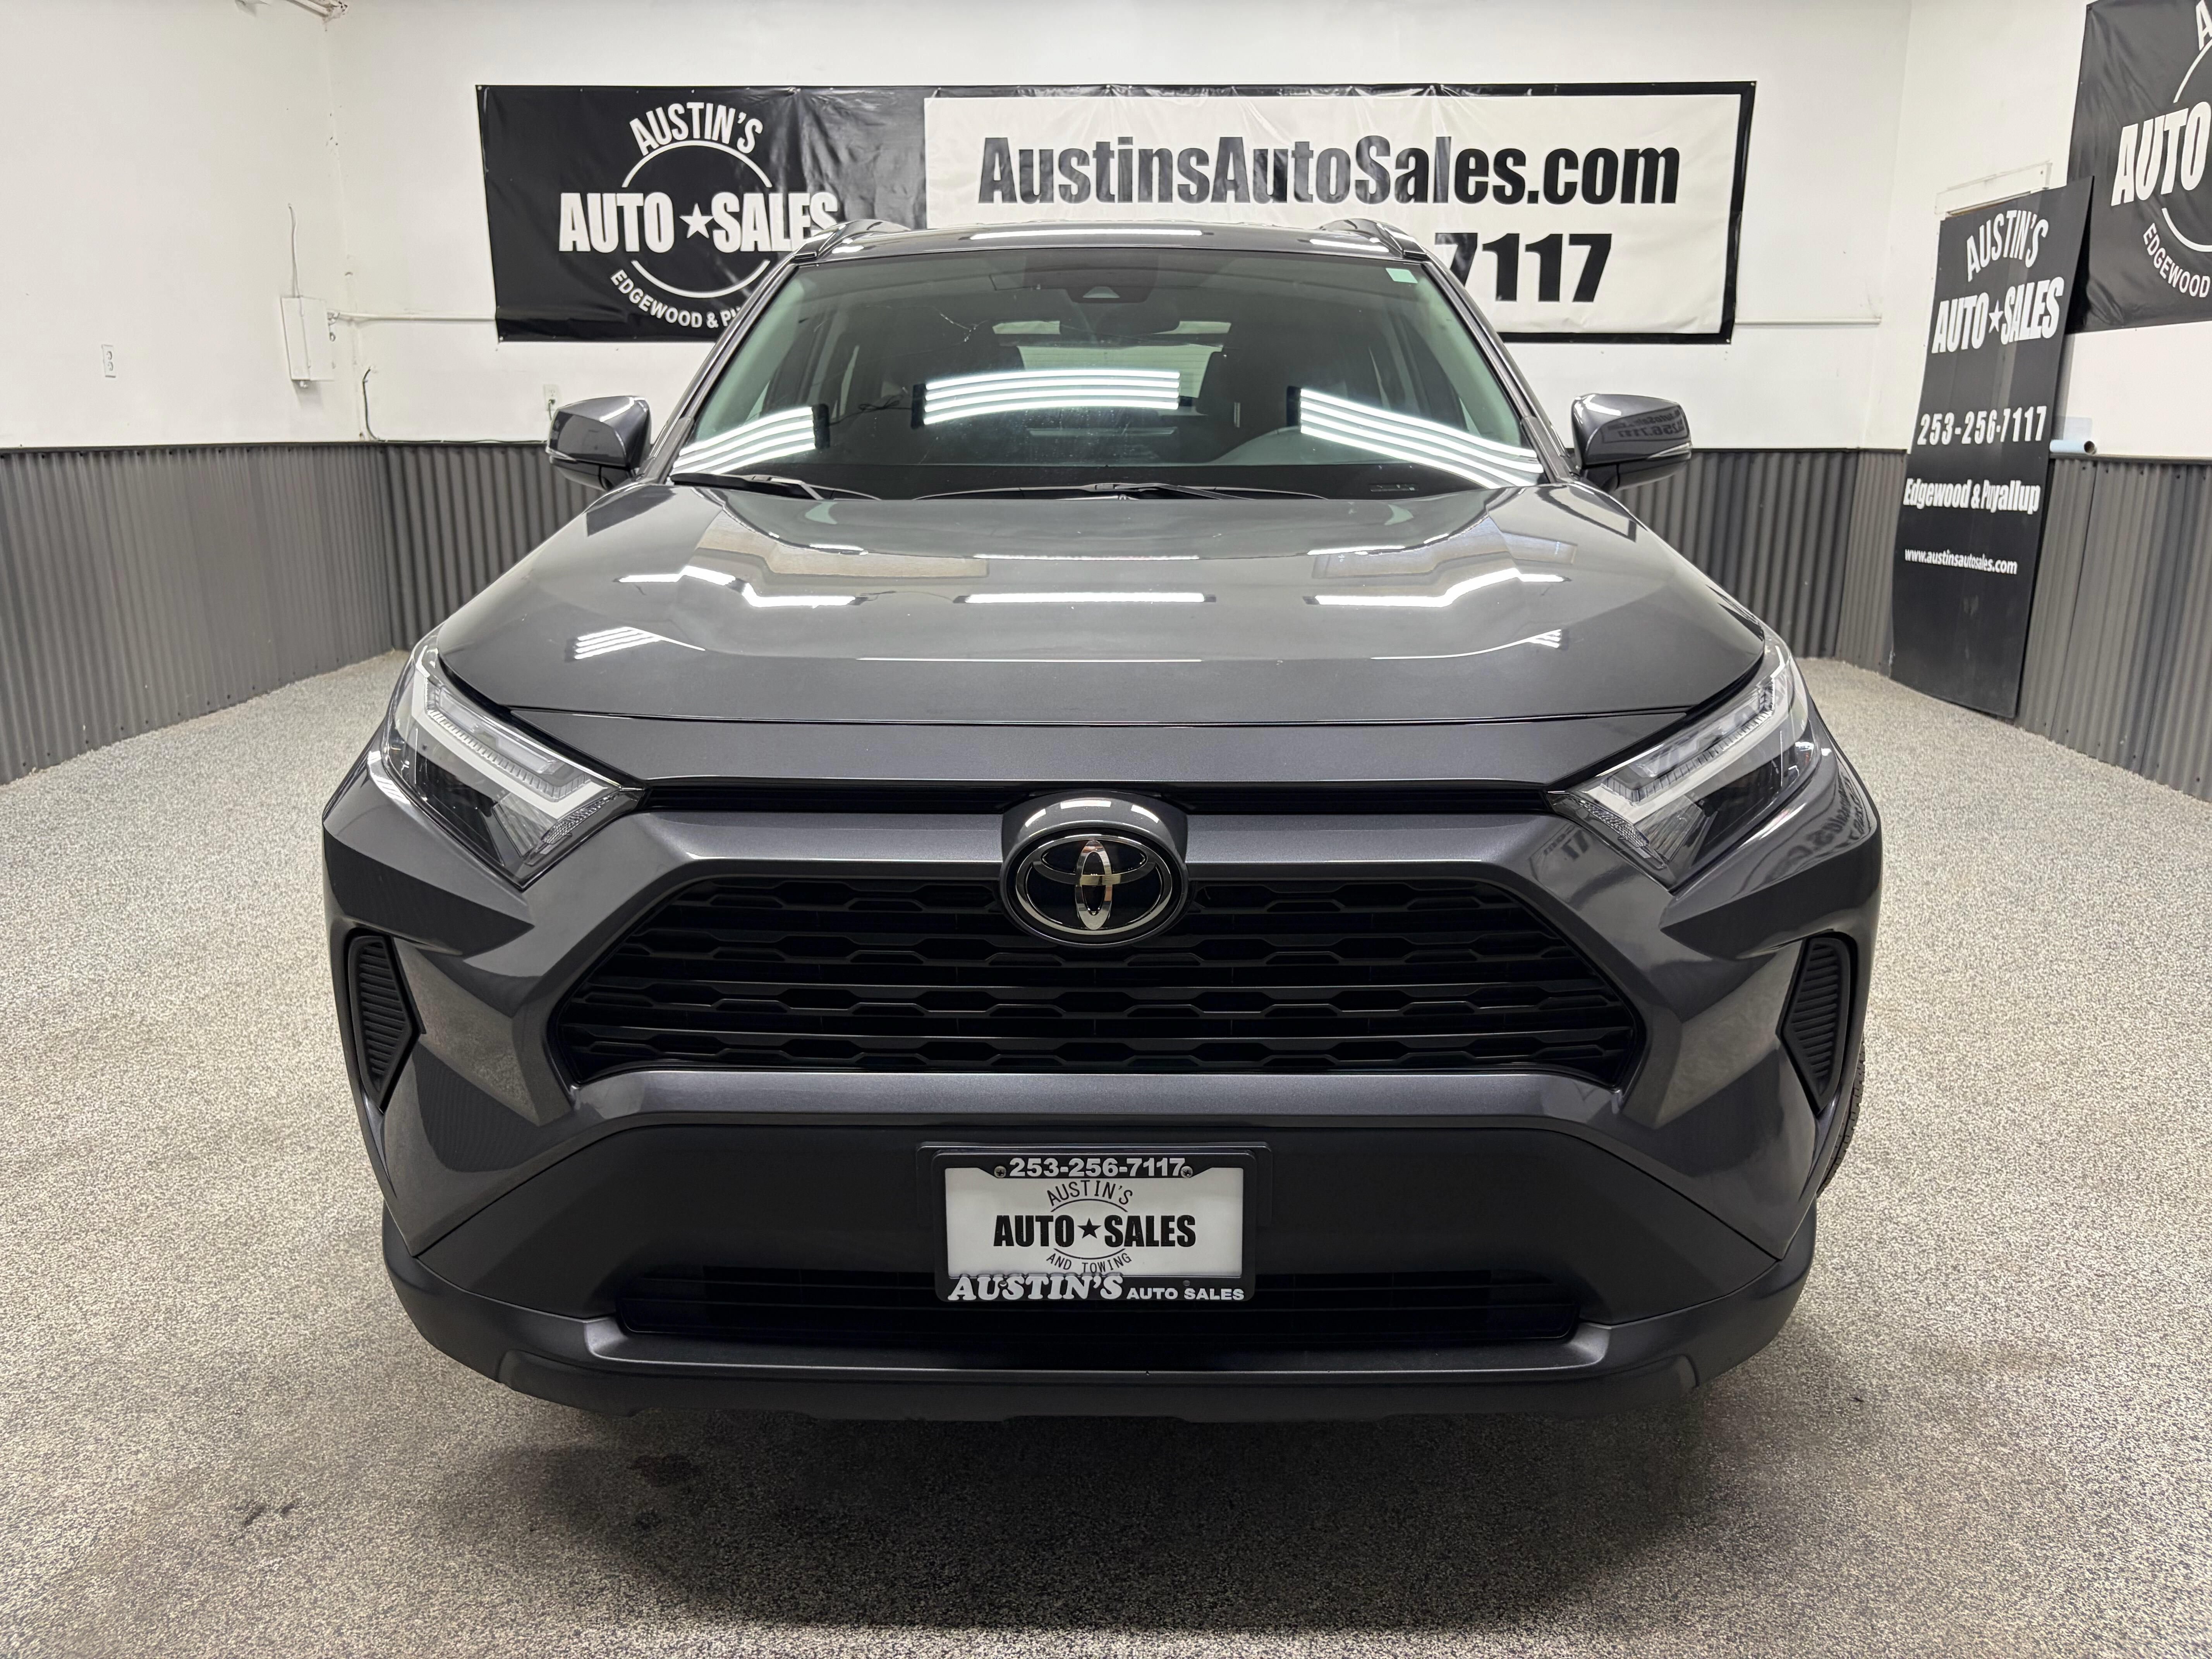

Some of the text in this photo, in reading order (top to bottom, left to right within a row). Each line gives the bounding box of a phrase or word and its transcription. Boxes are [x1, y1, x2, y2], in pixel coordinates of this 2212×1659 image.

[629, 102, 763, 156] AUSTIN'S
[978, 135, 1680, 204] AustinsAutoSales.com
[2111, 101, 2211, 206] AUTO
[559, 192, 838, 253] AUTO SALES
[1966, 210, 2049, 282] AUSTIN'S
[2143, 223, 2210, 297] EDGEWOOD
[610, 269, 702, 328] EDGEWOOD
[706, 311, 719, 328] &
[1932, 277, 2064, 354] AUTO SALES
[1917, 405, 2047, 445] 253-256-7117
[1903, 478, 2041, 515] Edgewood & Puyallup
[1905, 549, 2018, 575] www.austinsautosales.com
[1010, 1158, 1185, 1177] 253-256-7117
[1047, 1180, 1133, 1206] AUSTIN'S
[993, 1215, 1196, 1247] AUTO SALES
[1046, 1253, 1132, 1273] AND TOWING
[947, 1274, 1244, 1301] AUSTIN'S AUTO SALES
